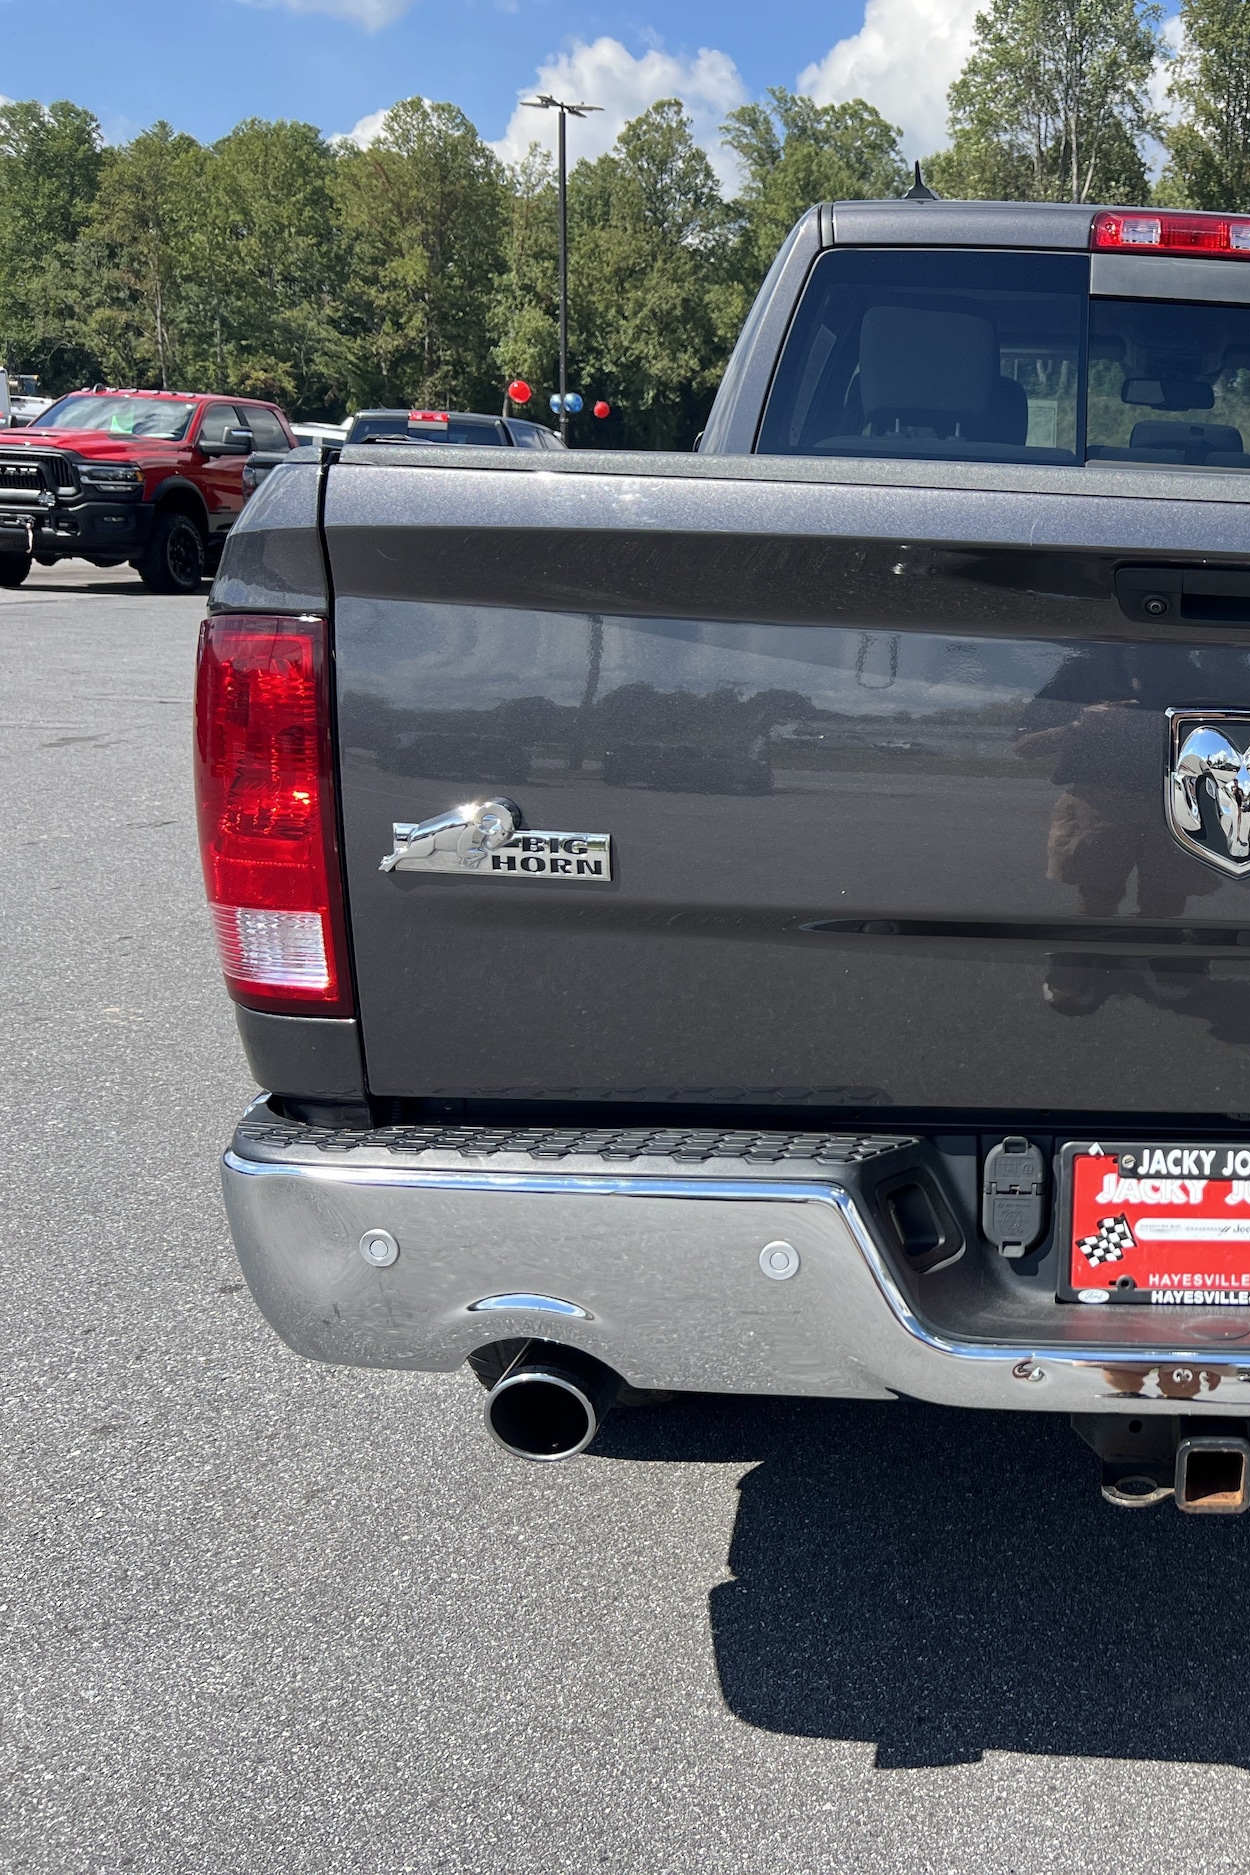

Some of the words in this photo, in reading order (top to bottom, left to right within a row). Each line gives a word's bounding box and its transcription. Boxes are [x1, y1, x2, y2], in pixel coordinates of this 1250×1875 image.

[521, 836, 589, 856] BIG
[491, 854, 603, 876] HORN
[1137, 1149, 1217, 1176] JACKY
[1095, 1173, 1209, 1206] JACKY
